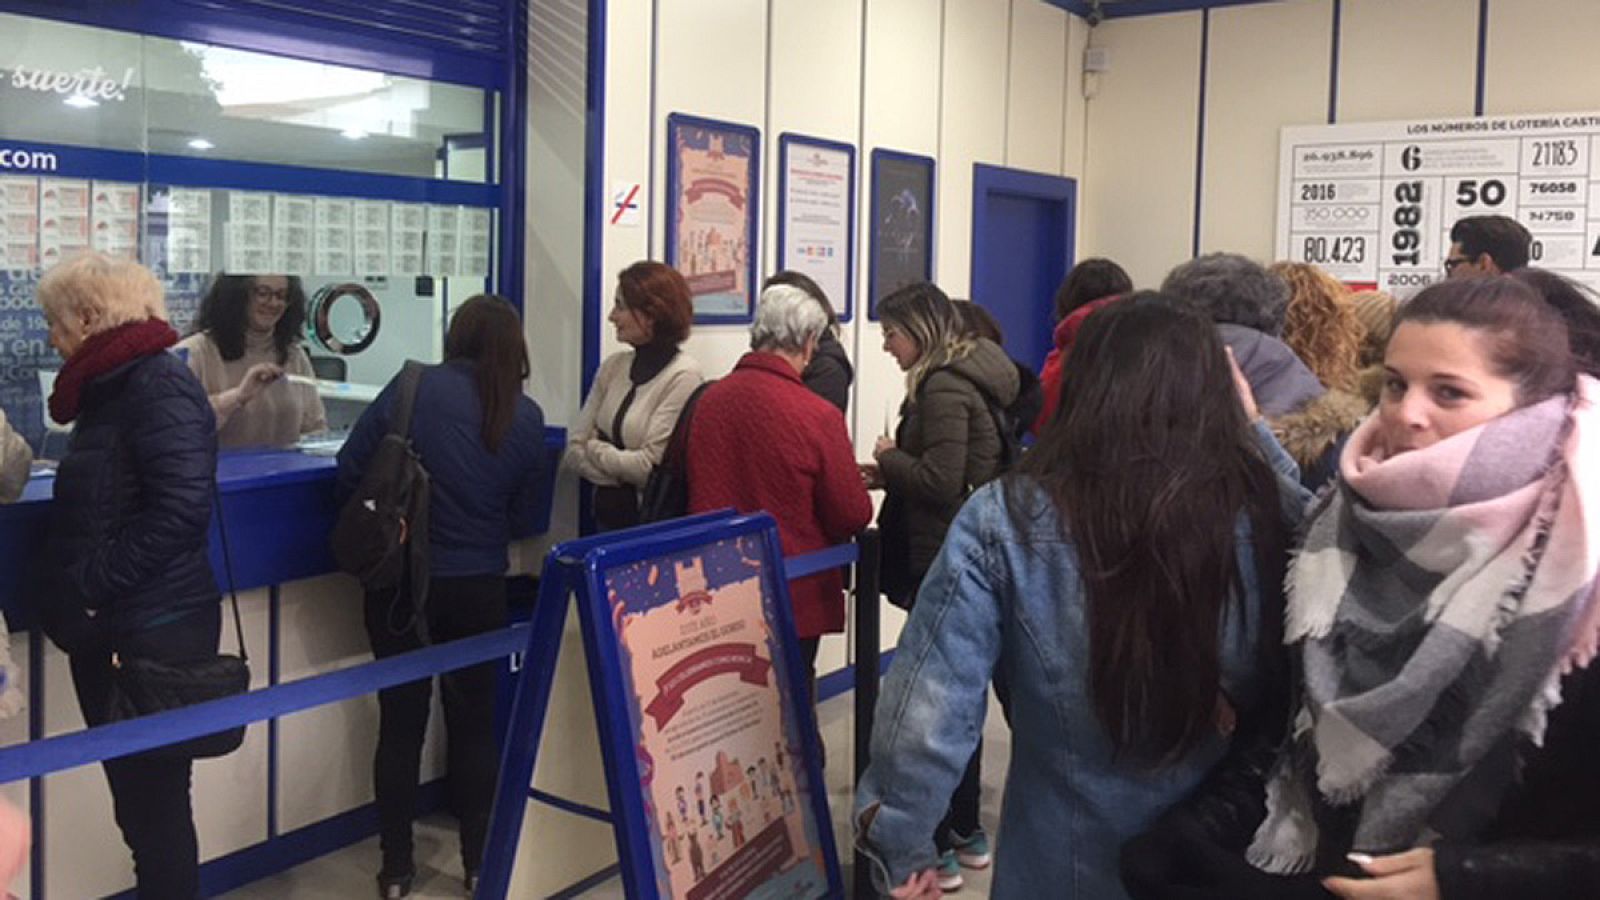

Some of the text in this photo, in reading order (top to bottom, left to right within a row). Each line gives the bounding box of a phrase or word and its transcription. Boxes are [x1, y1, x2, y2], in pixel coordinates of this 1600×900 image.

[12, 64, 134, 101] suerte!
[1407, 124, 1429, 135] LOS
[1491, 120, 1508, 131] DE
[1401, 145, 1422, 172] 6
[1532, 140, 1578, 166] 21183
[1301, 183, 1336, 201] 2016
[1456, 179, 1506, 207] 50
[1391, 180, 1422, 266] 1982
[1304, 236, 1366, 264] 80.423
